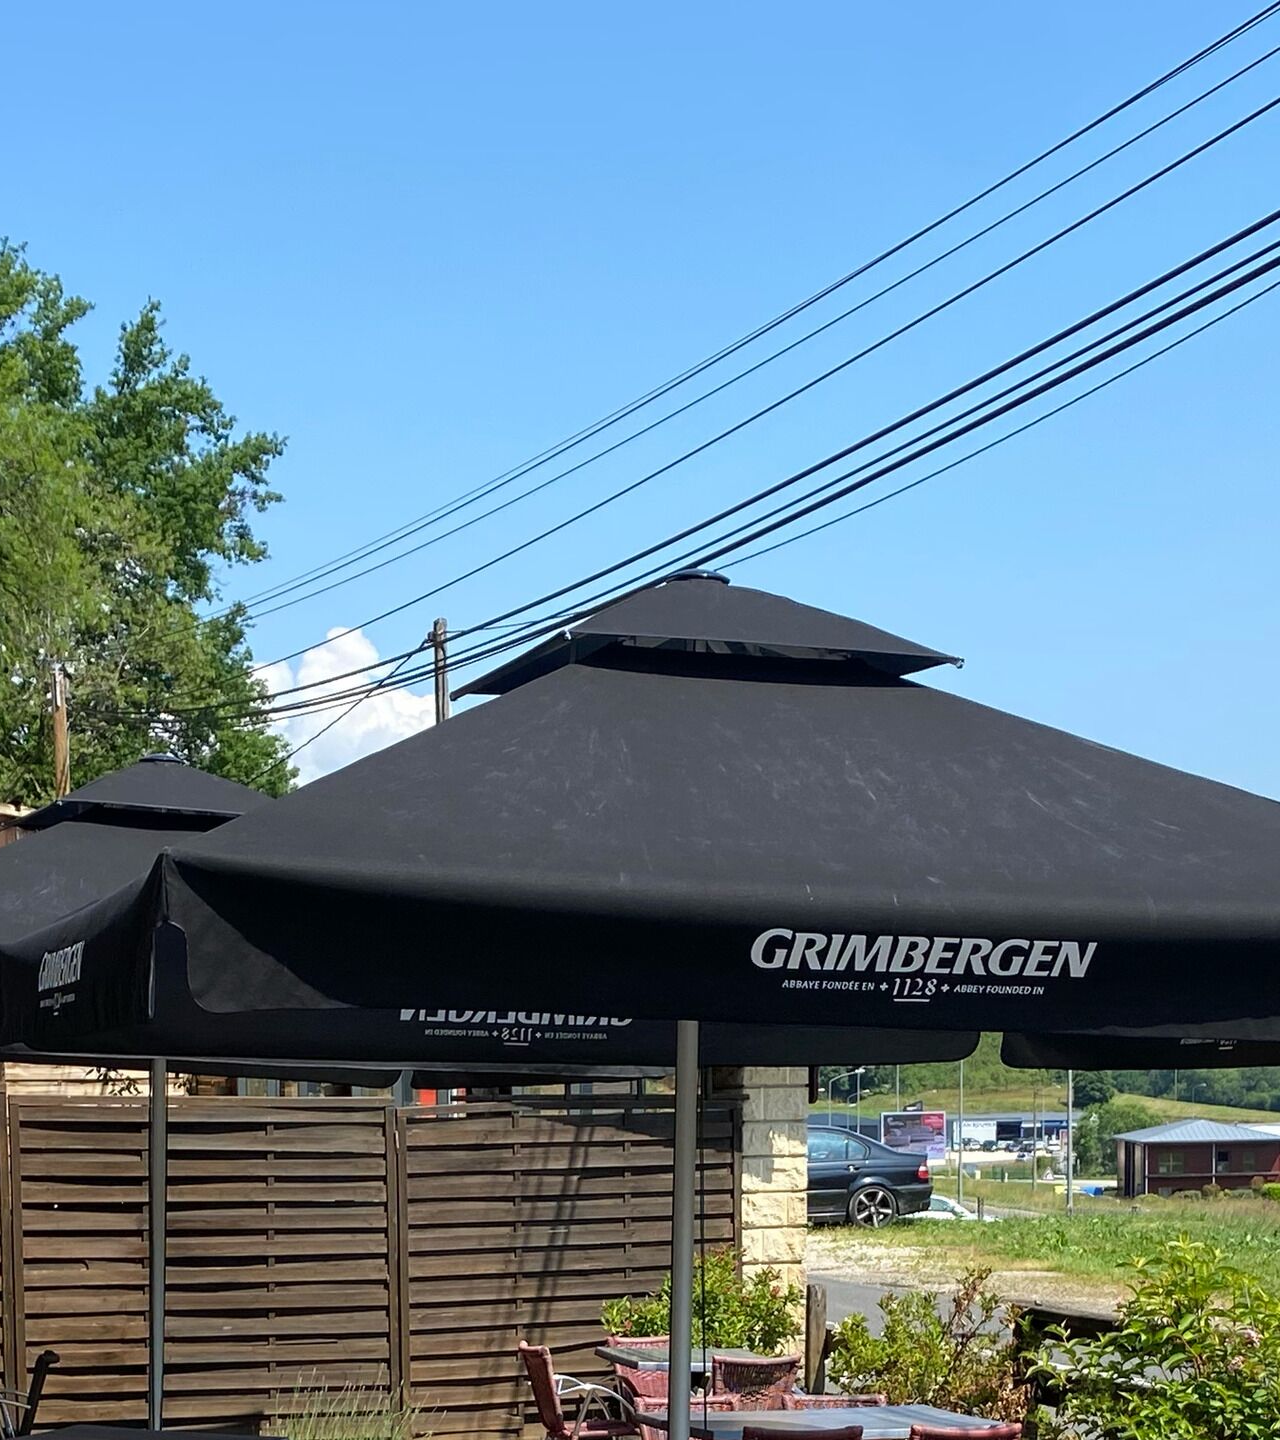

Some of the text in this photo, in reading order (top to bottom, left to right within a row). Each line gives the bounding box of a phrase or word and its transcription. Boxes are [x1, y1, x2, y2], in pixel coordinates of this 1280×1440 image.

[750, 928, 1098, 978] GRIMBERGEN
[782, 978, 1045, 997] ABBAYE FONDÉE EN 1128 ABBEY FOUNDED IN
